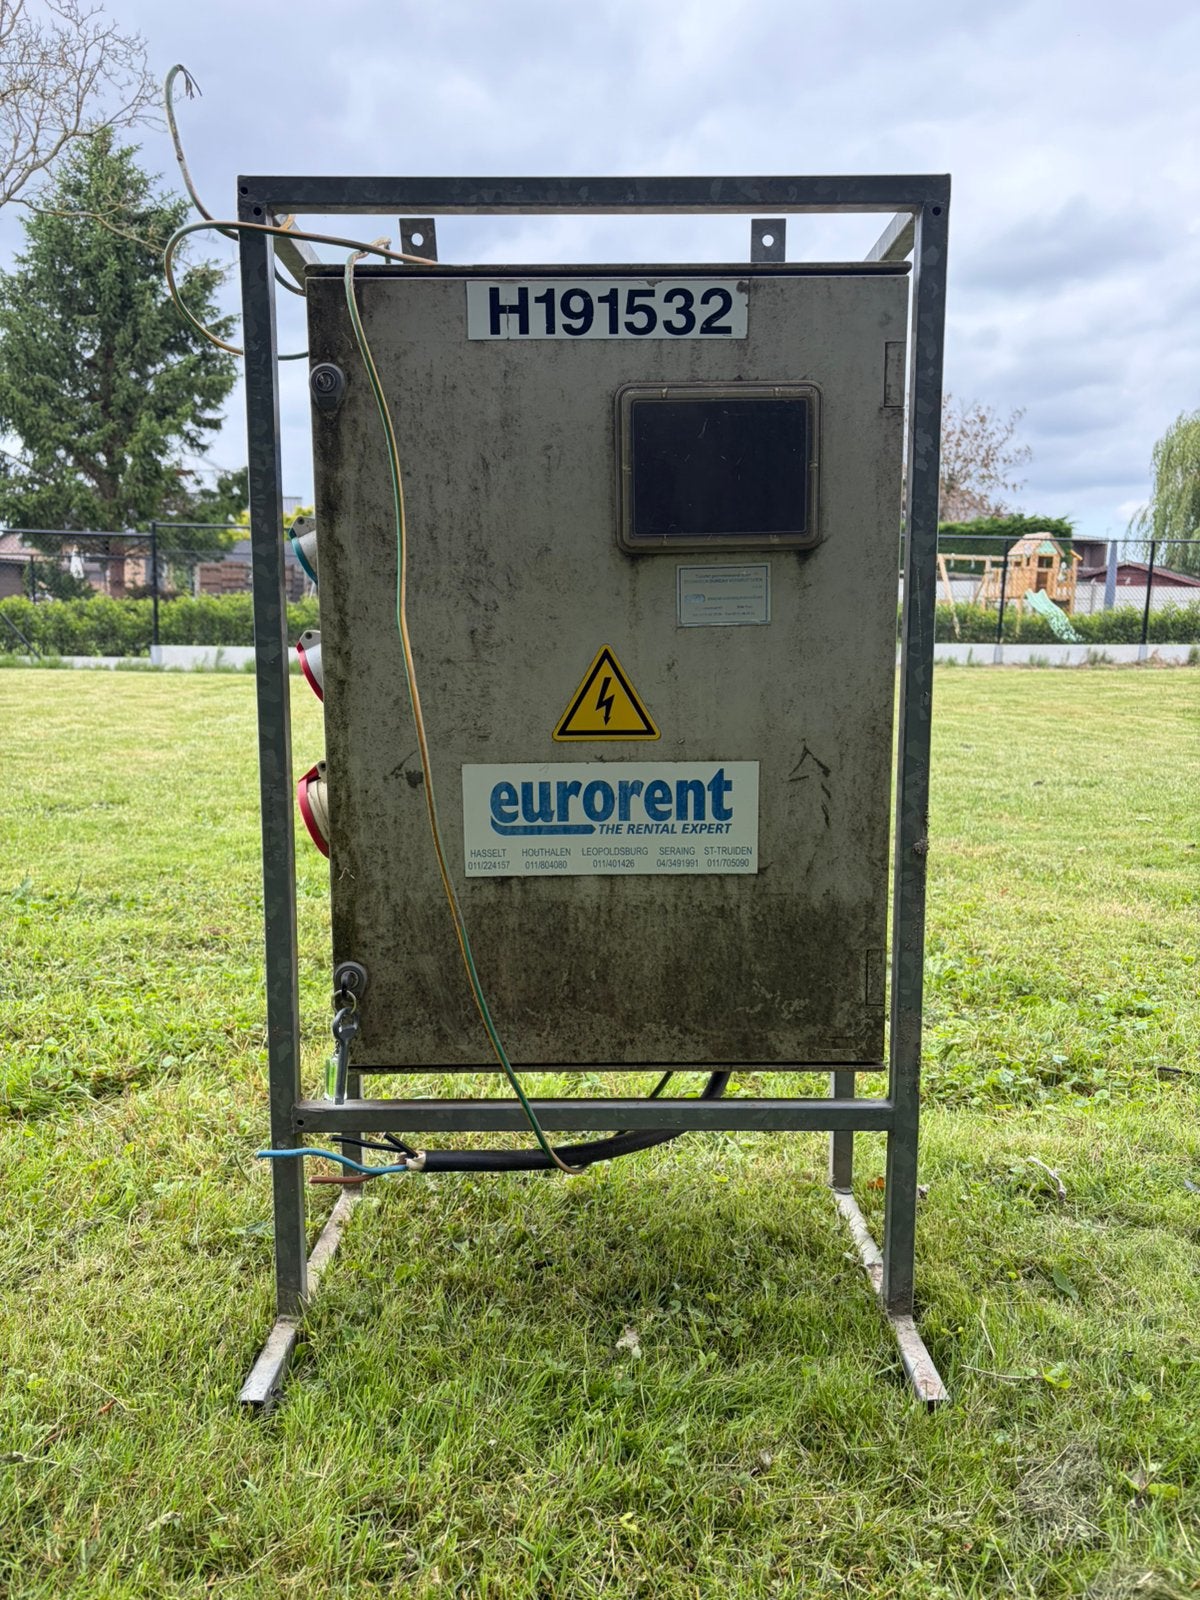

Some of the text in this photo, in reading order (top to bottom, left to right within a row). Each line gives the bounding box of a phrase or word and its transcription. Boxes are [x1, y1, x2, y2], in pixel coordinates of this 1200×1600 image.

[488, 286, 733, 336] H191532
[490, 768, 734, 823] eurorent
[598, 823, 732, 836] THE RENTAL EXPERT
[470, 846, 753, 858] HASSELT HOUTHALEN LEOPOLDSBURG SERAING ST-TRUIDEN
[467, 858, 750, 870] 011/224157 011/804080 011/401426 04/3491991 011/705090
